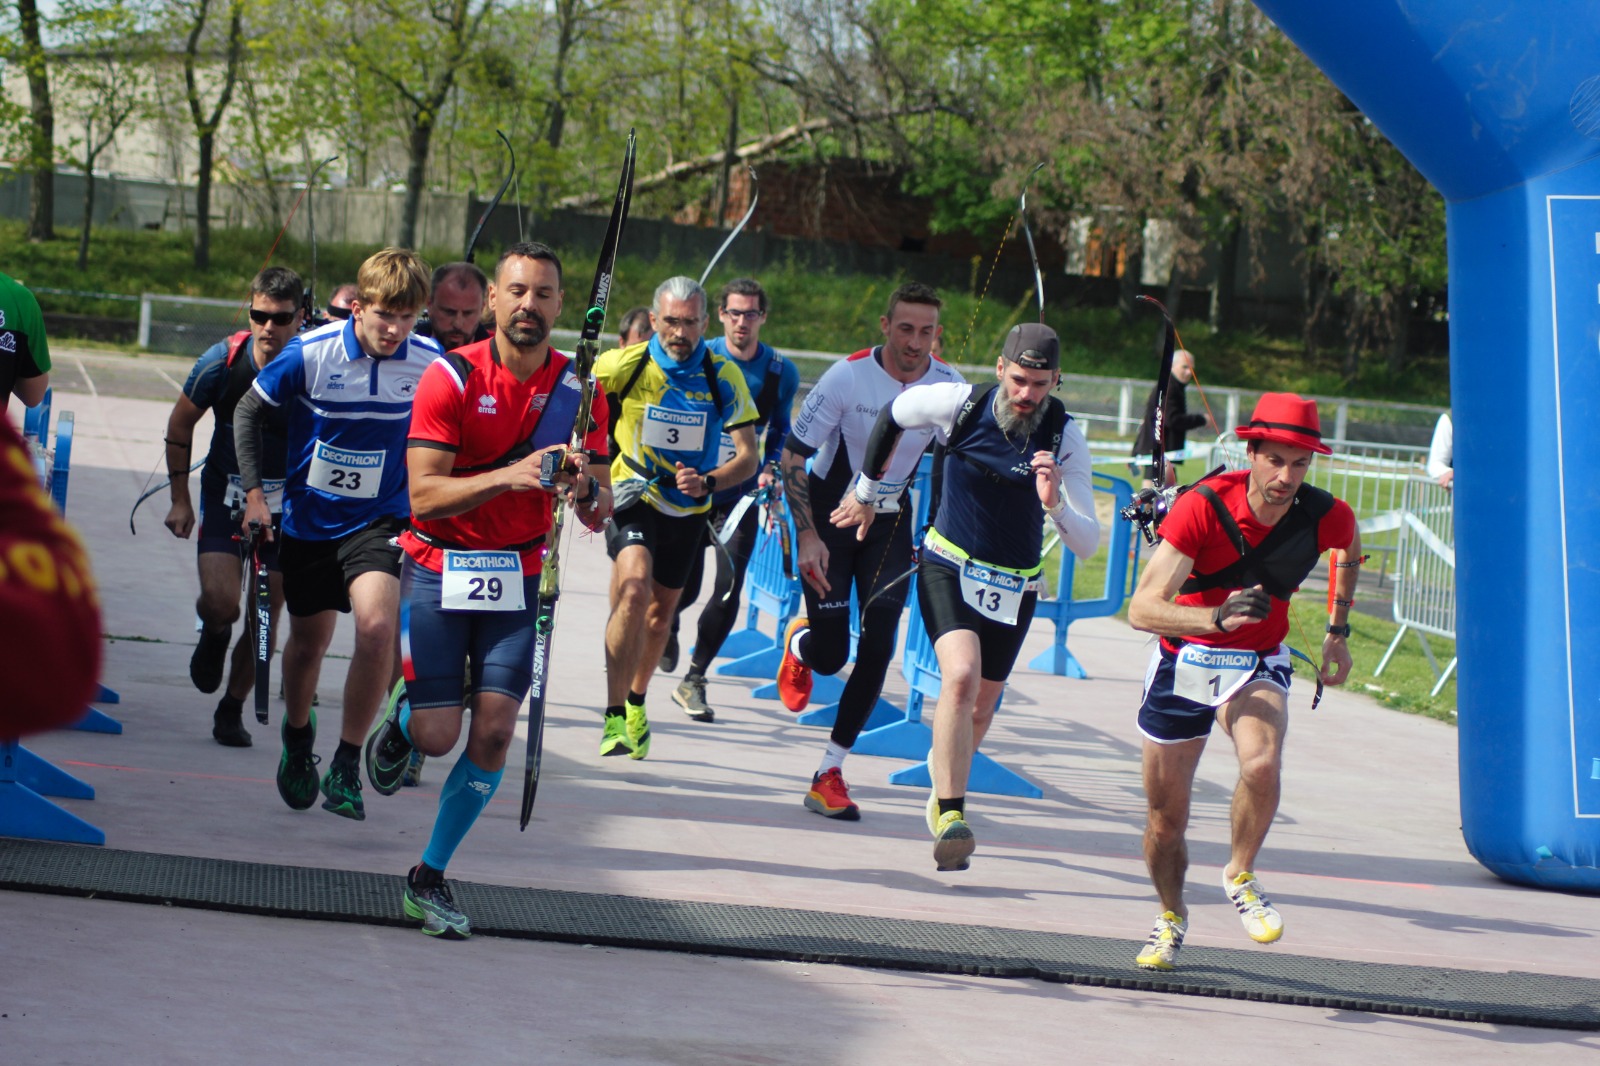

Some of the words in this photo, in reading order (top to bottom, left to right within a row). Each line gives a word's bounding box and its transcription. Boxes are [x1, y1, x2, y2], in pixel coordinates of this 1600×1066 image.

[651, 409, 701, 425] DECATHLON
[666, 428, 680, 444] 3
[321, 448, 379, 466] DECATHLON
[328, 469, 362, 491] 23
[453, 556, 516, 569] DECATHLON
[967, 567, 1021, 589] DECATHLON
[467, 577, 503, 601] 29
[975, 588, 1002, 612] 13
[258, 608, 269, 626] SF
[258, 624, 267, 662] ARCHERY
[1187, 649, 1253, 667] DECATHLON
[1208, 675, 1222, 697] 1
